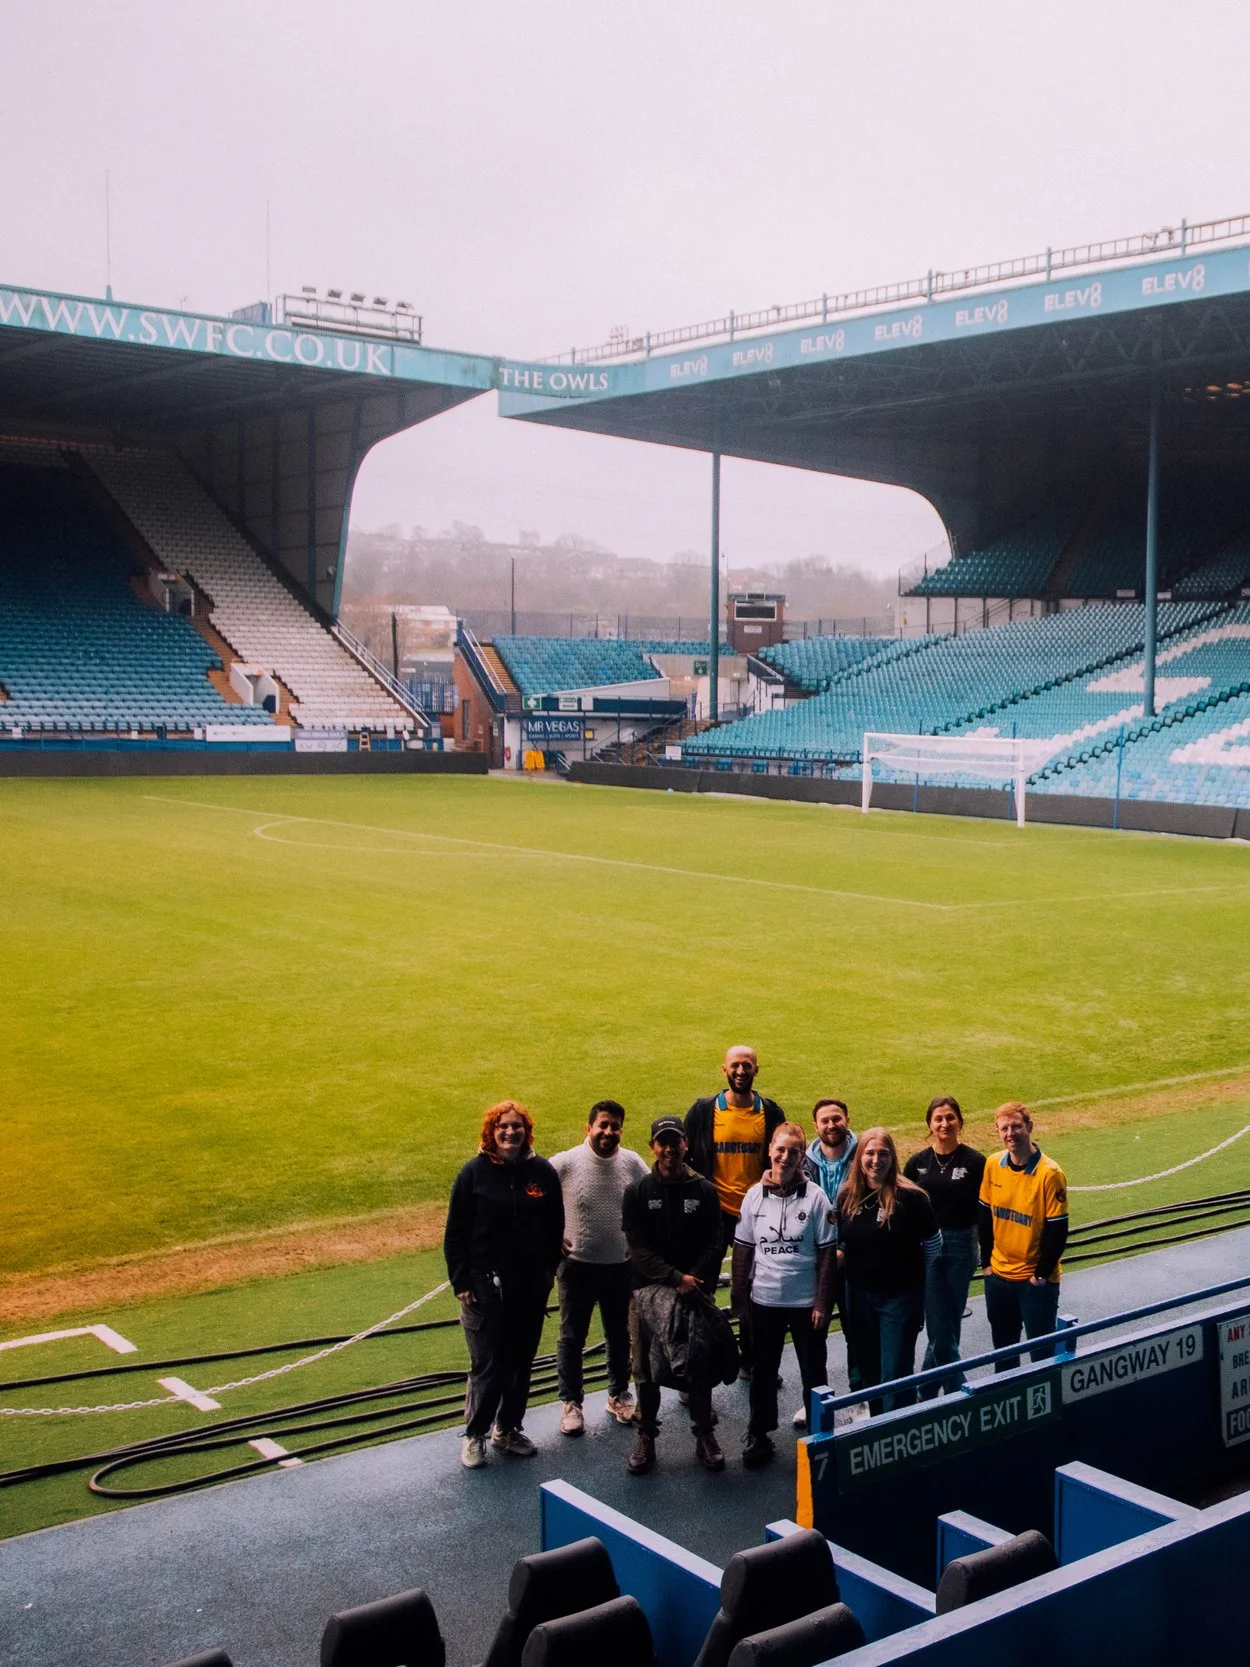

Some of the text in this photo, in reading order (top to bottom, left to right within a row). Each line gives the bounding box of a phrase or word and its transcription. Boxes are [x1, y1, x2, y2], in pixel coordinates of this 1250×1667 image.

[1141, 263, 1205, 295] ELEV8
[1044, 281, 1101, 312] ELEV8
[955, 299, 1008, 327] ELEV8
[874, 314, 922, 340] ELEV8
[800, 328, 844, 353] ELEV8
[670, 354, 708, 378] ELEV8
[732, 343, 773, 368] ELEV8
[499, 367, 609, 391] THE OWLS
[528, 720, 580, 733] MR VEGAS
[764, 1245, 799, 1255] PEACE
[1227, 1324, 1246, 1343] ANY
[1070, 1334, 1196, 1393] GANGWAY 19
[849, 1395, 1021, 1475] EMERGENCY EXIT
